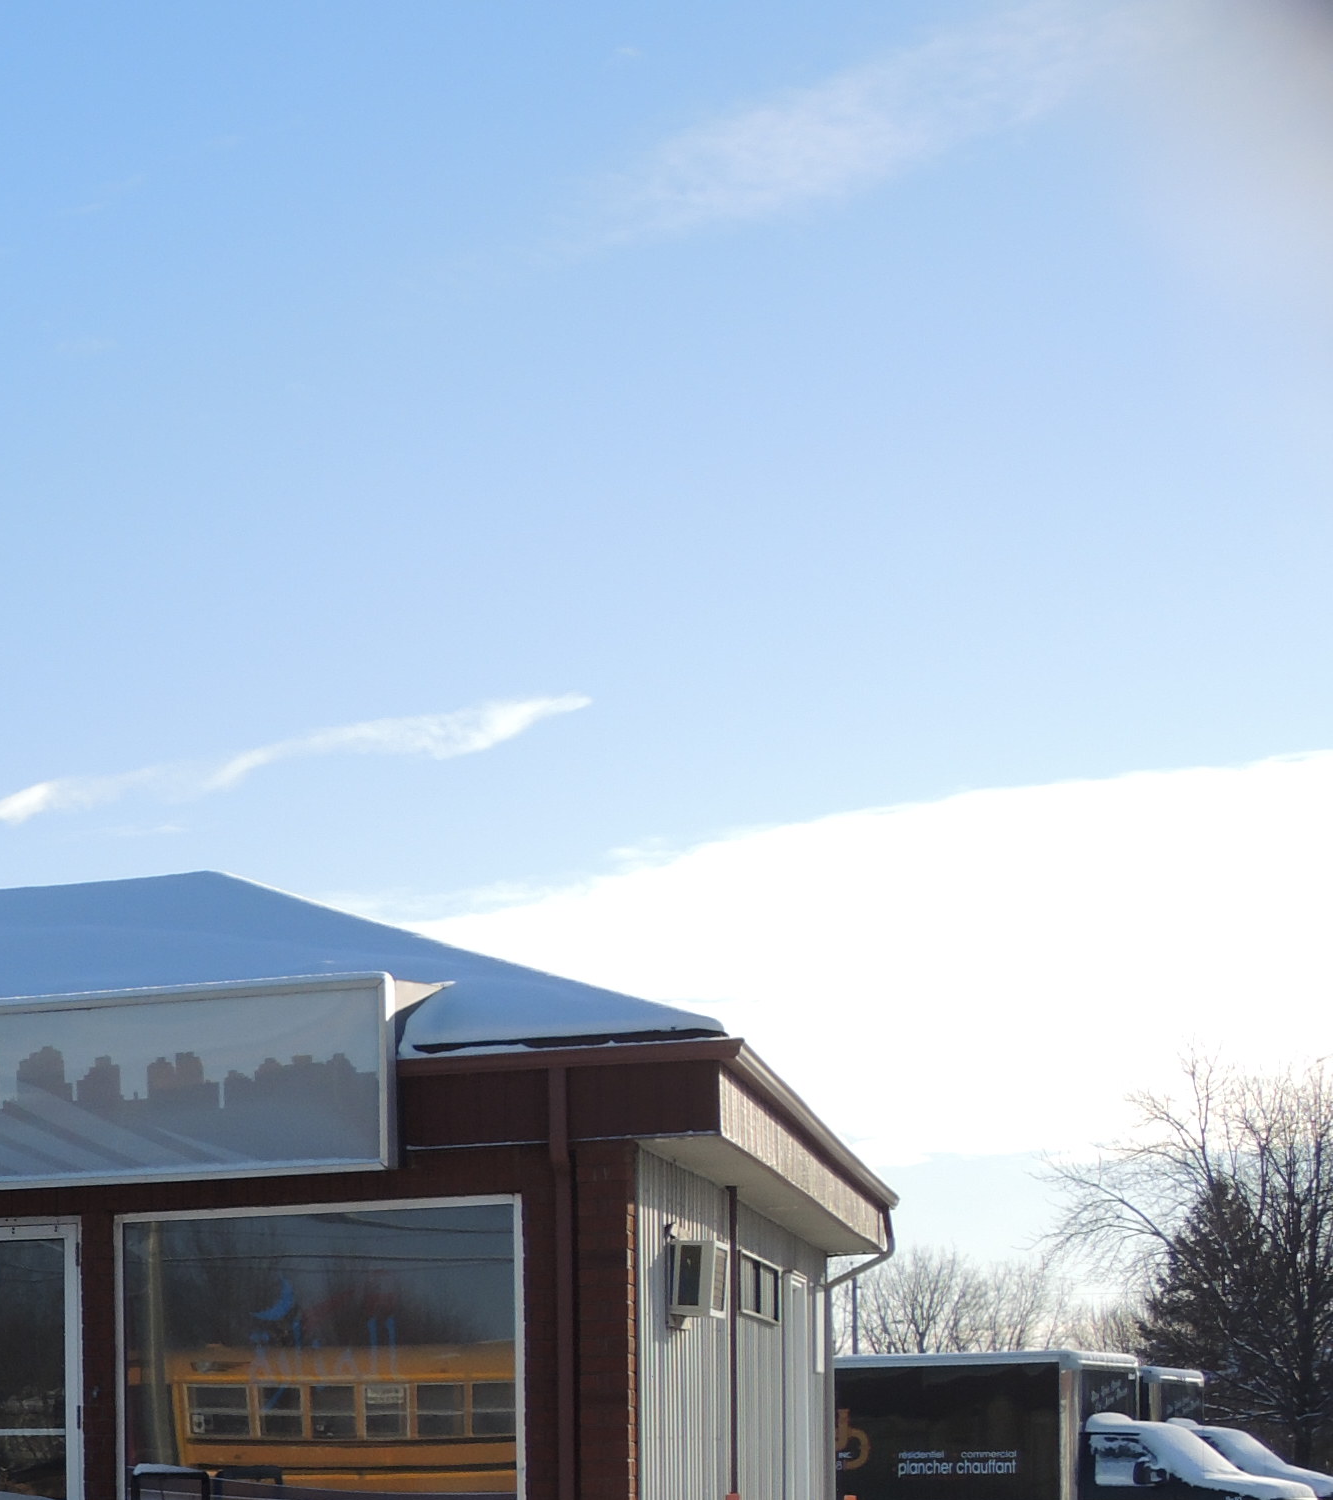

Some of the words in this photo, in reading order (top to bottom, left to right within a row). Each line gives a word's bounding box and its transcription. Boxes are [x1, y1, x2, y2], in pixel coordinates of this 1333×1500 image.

[960, 1450, 1018, 1458] commercial
[897, 1459, 953, 1479] plancher
[956, 1458, 1017, 1476] chauffant
